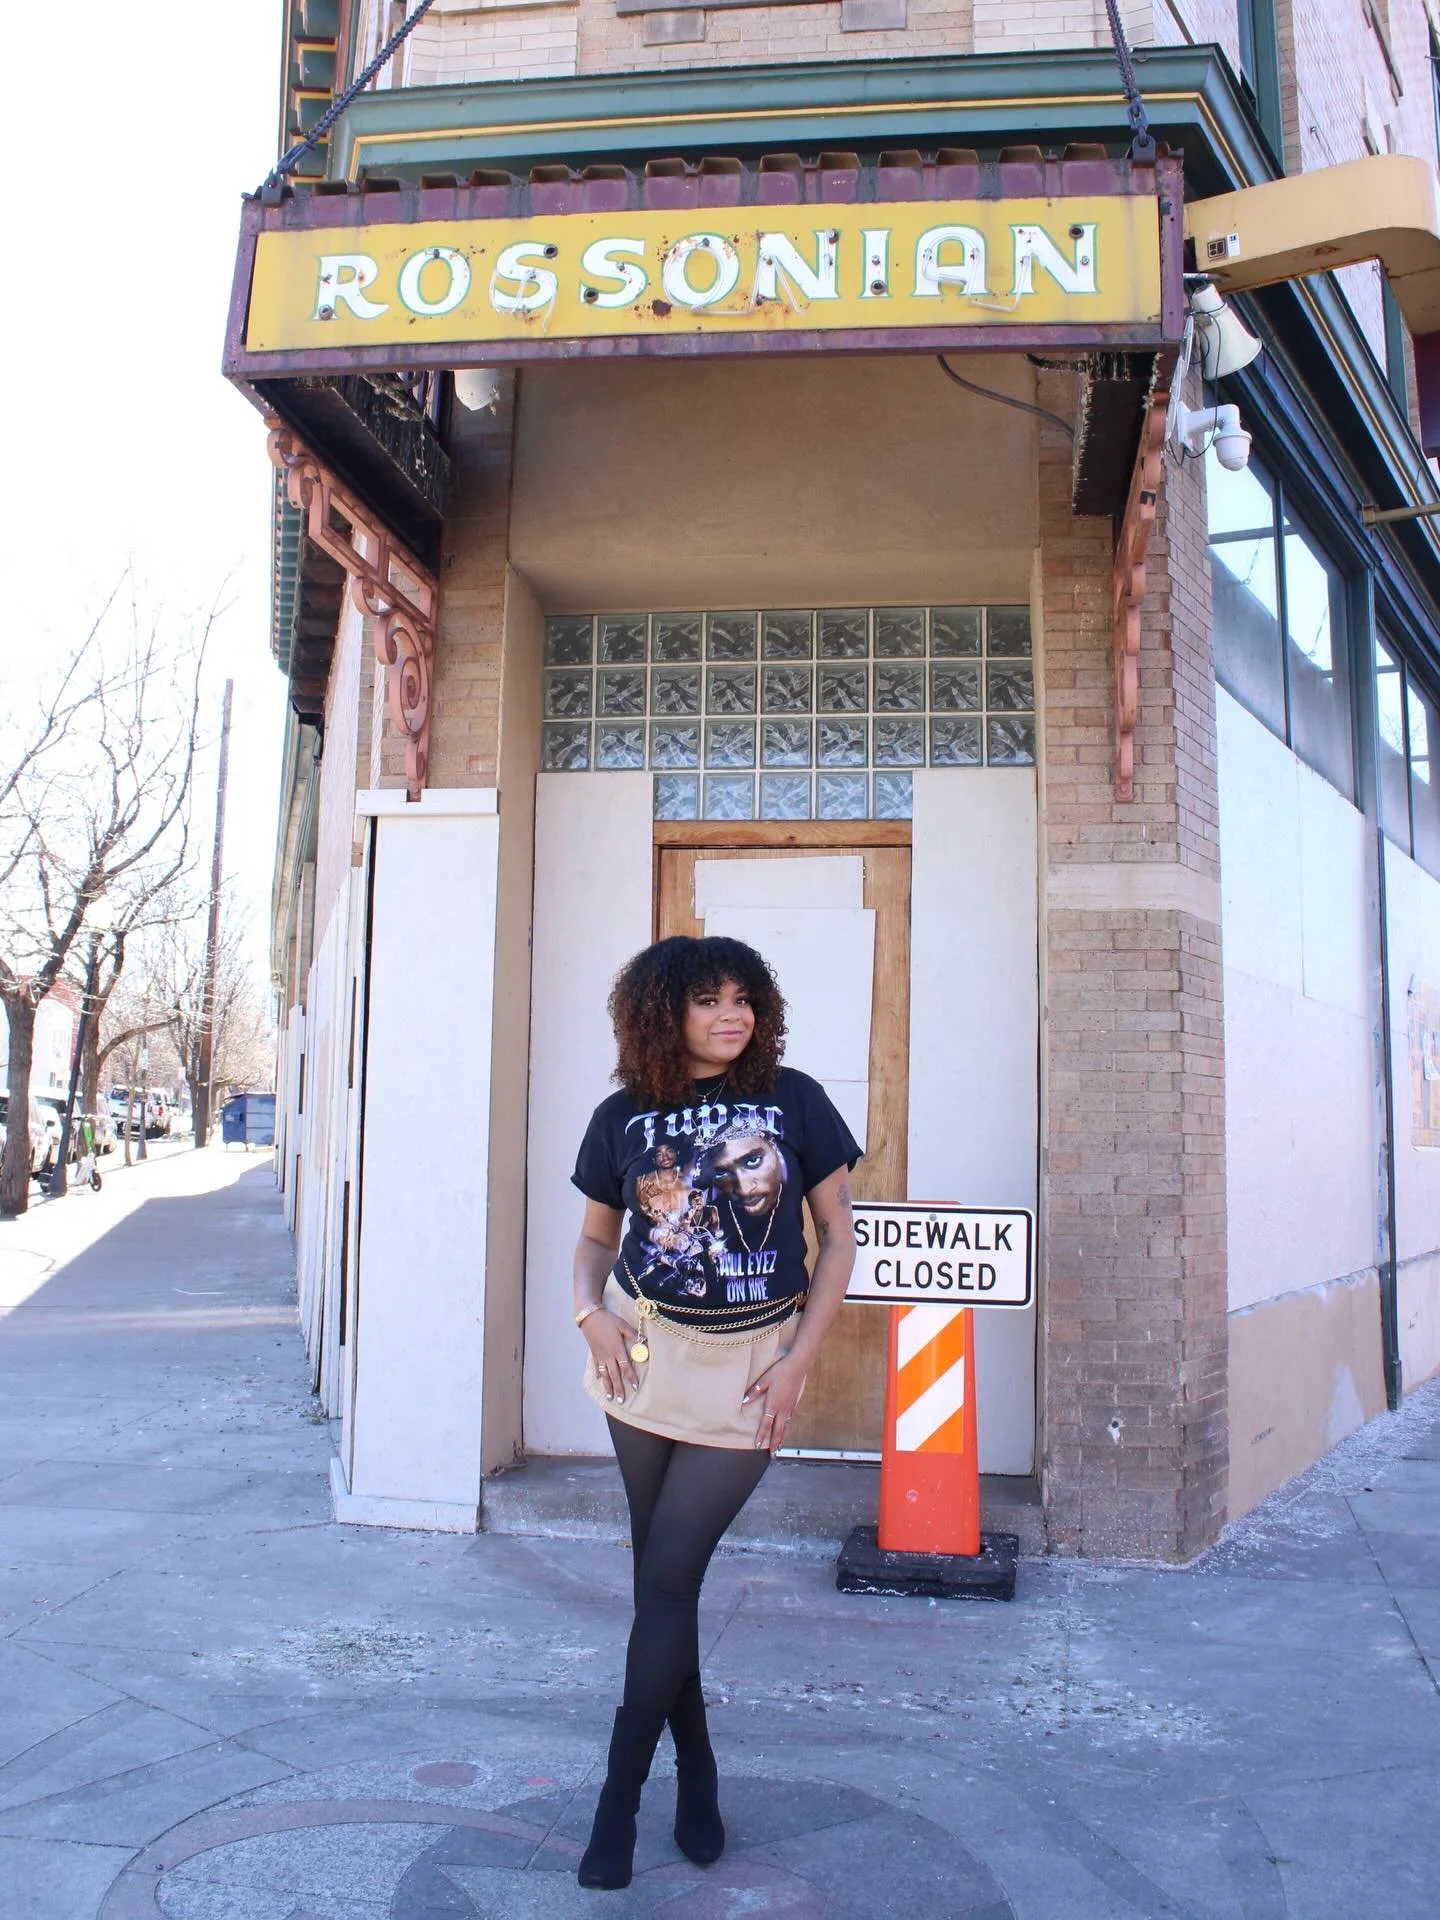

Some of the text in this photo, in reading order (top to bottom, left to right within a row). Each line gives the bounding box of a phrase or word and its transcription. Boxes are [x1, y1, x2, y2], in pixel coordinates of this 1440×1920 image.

[313, 224, 1101, 320] ROSSONIAN
[853, 1219, 1013, 1251] SIDEWALK
[718, 1250, 778, 1277] ALL EYEZ
[874, 1259, 997, 1291] CLOSED
[727, 1277, 769, 1302] ON ME
